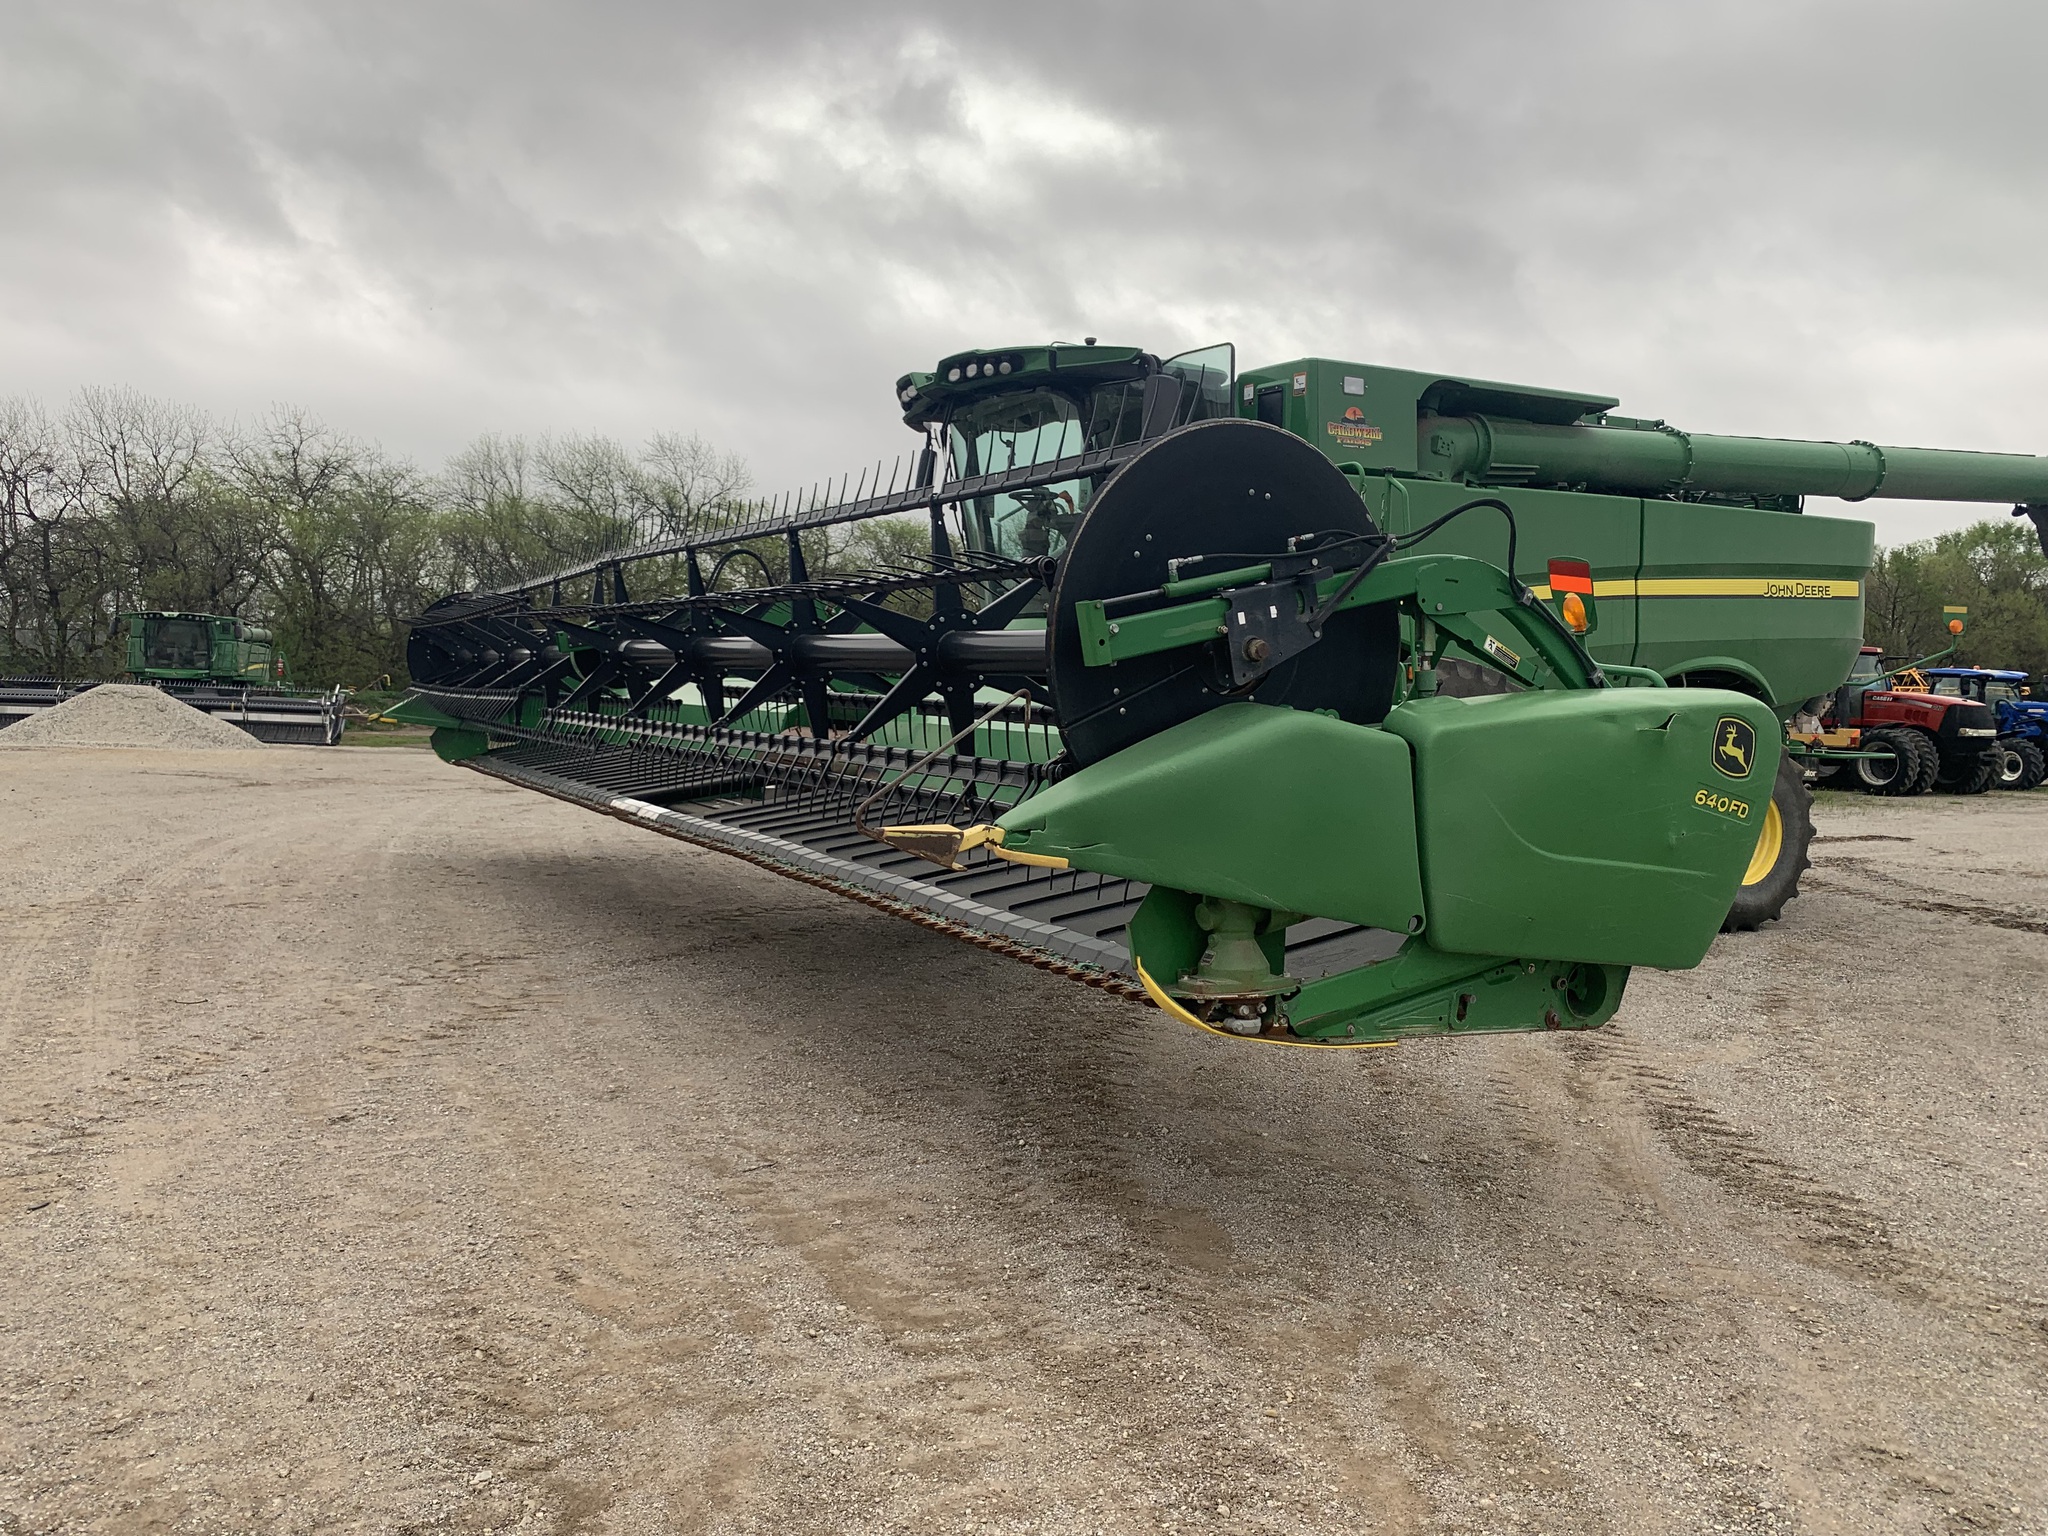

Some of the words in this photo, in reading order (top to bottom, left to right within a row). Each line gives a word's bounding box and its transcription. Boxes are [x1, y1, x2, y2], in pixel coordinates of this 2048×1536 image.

[1763, 581, 1794, 597] JOHN
[1795, 582, 1832, 598] DEERE
[1694, 789, 1749, 819] 640FD
